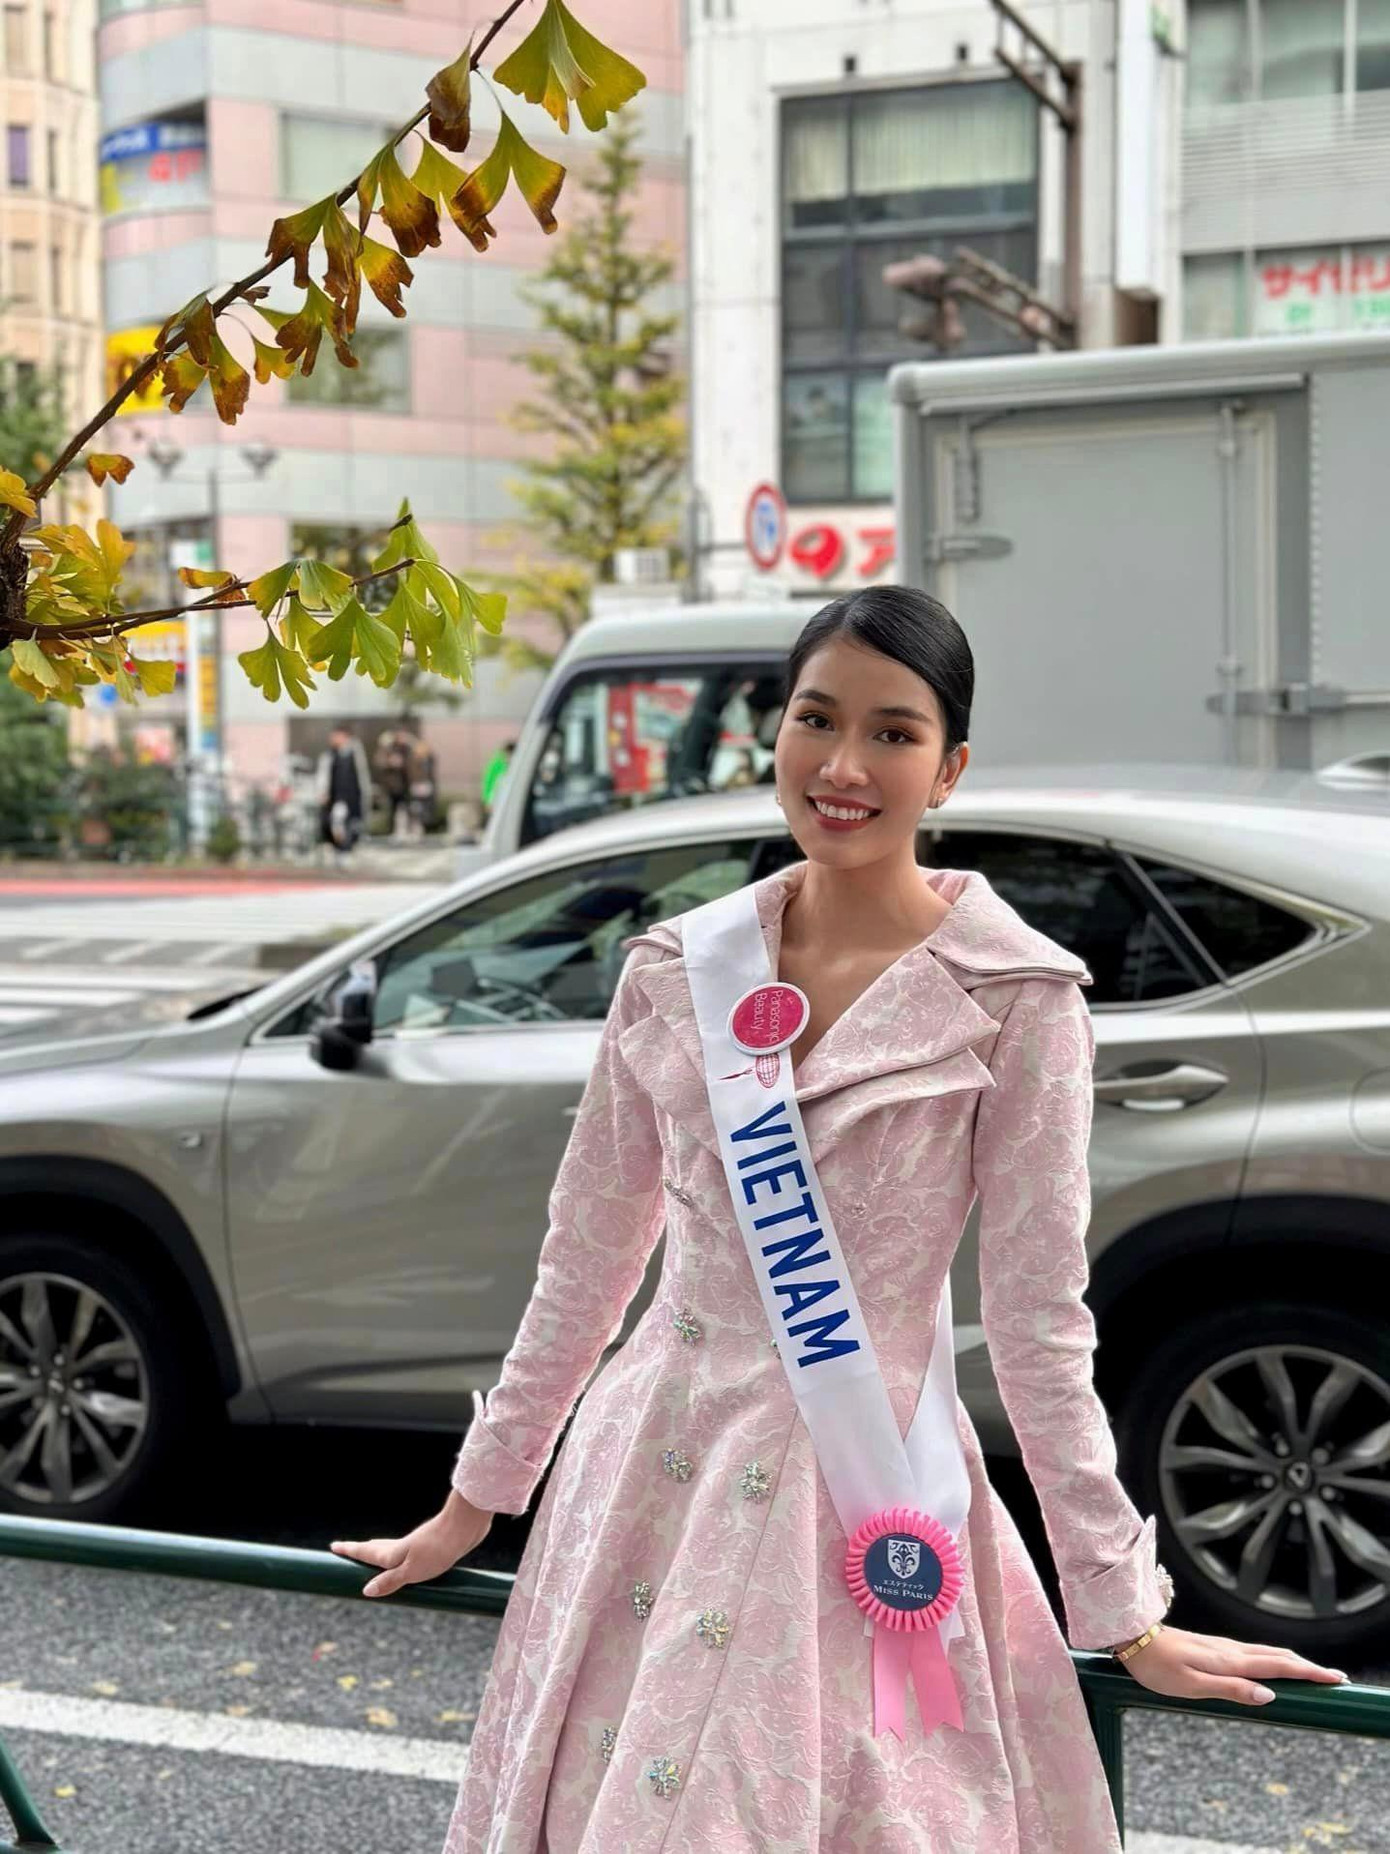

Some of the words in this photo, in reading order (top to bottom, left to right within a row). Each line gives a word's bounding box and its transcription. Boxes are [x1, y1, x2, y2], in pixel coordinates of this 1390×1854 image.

[751, 993, 767, 1030] Beauty
[770, 990, 783, 1043] Panasonic
[730, 1100, 861, 1368] VIETNAM
